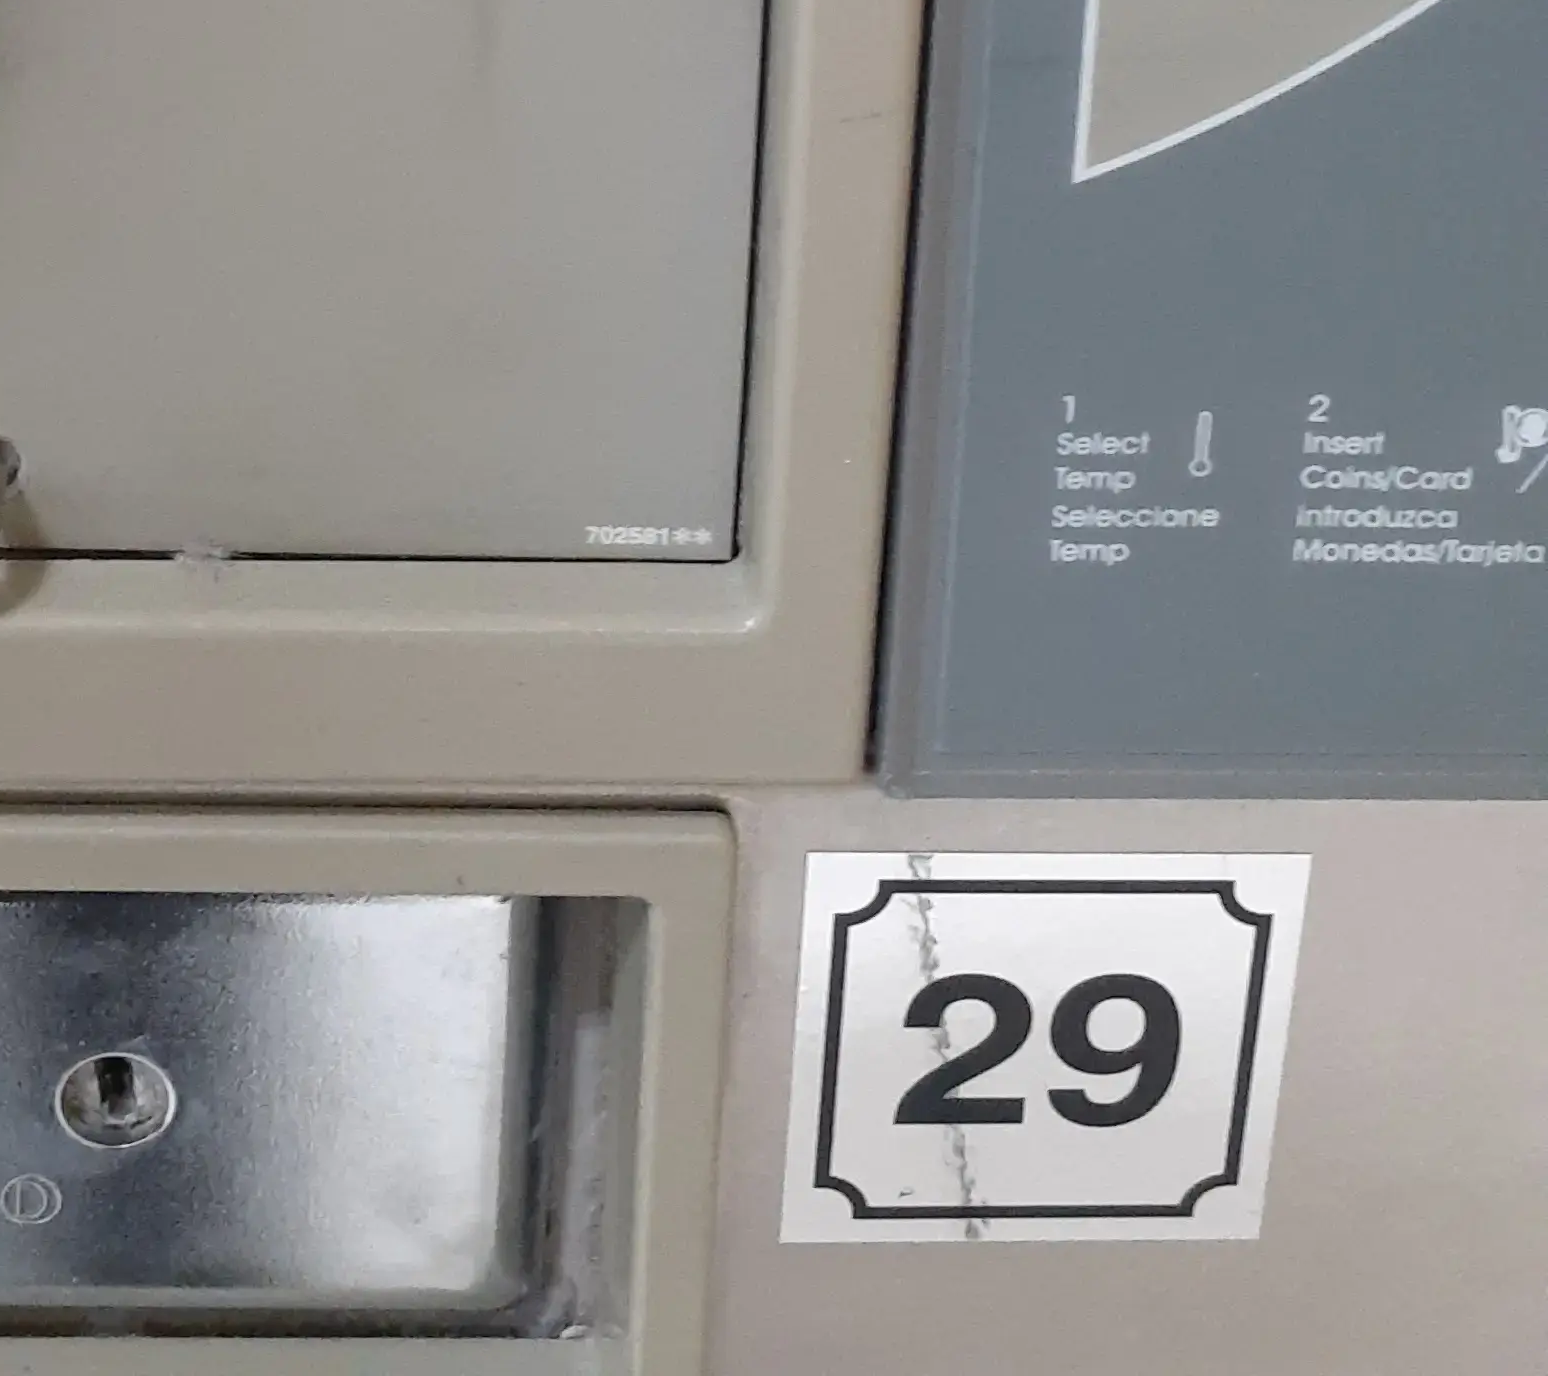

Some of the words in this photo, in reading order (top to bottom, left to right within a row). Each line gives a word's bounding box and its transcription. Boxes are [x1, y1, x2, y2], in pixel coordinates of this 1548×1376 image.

[1061, 394, 1077, 424] 1
[1307, 393, 1331, 423] 2
[1056, 431, 1151, 456] Select
[1302, 432, 1386, 455] Insert
[1054, 466, 1137, 494] Temp
[1299, 464, 1474, 492] Coins/Card
[1051, 504, 1221, 528] Seleccione
[1295, 504, 1459, 529] Introduzca
[1049, 538, 1131, 566] Temp
[1291, 538, 1547, 568] Monedas/Tarjeta
[893, 973, 1183, 1127] 29
